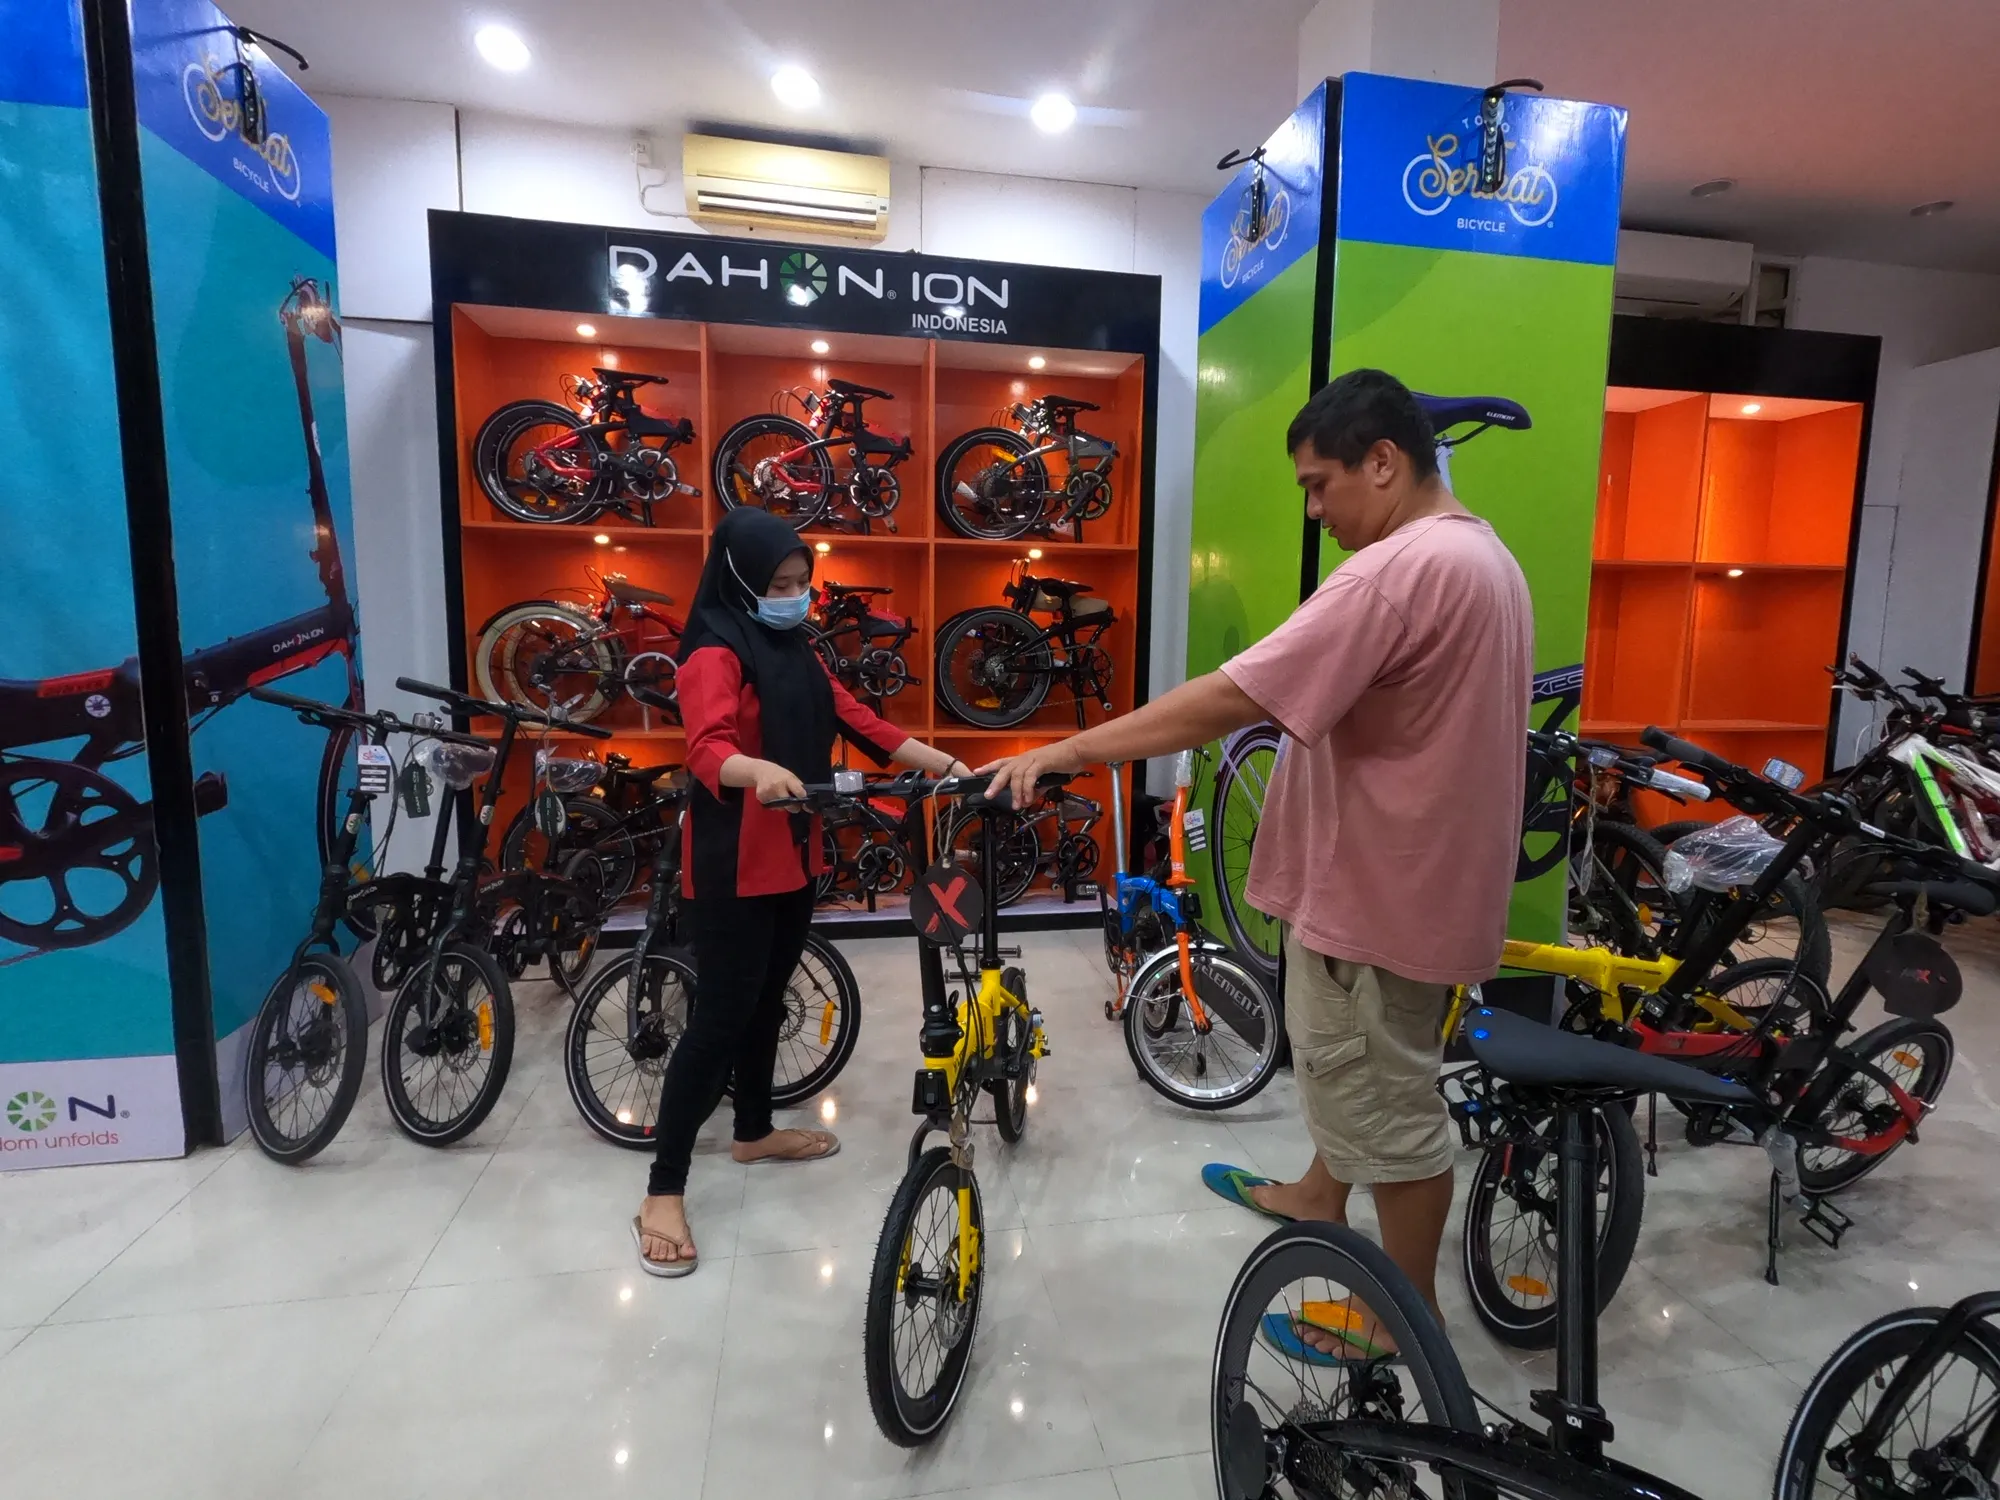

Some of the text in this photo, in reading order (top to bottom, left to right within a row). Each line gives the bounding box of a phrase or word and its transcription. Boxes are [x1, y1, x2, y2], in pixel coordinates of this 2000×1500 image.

[1462, 116, 1510, 133] TOO
[232, 157, 270, 194] BICYCLE
[1457, 217, 1506, 233] BICYCLE
[912, 271, 1009, 308] ION
[911, 312, 1008, 335] INDONESIA
[1201, 965, 1262, 1017] ELEMENT
[45, 1131, 119, 1149] unfolds
